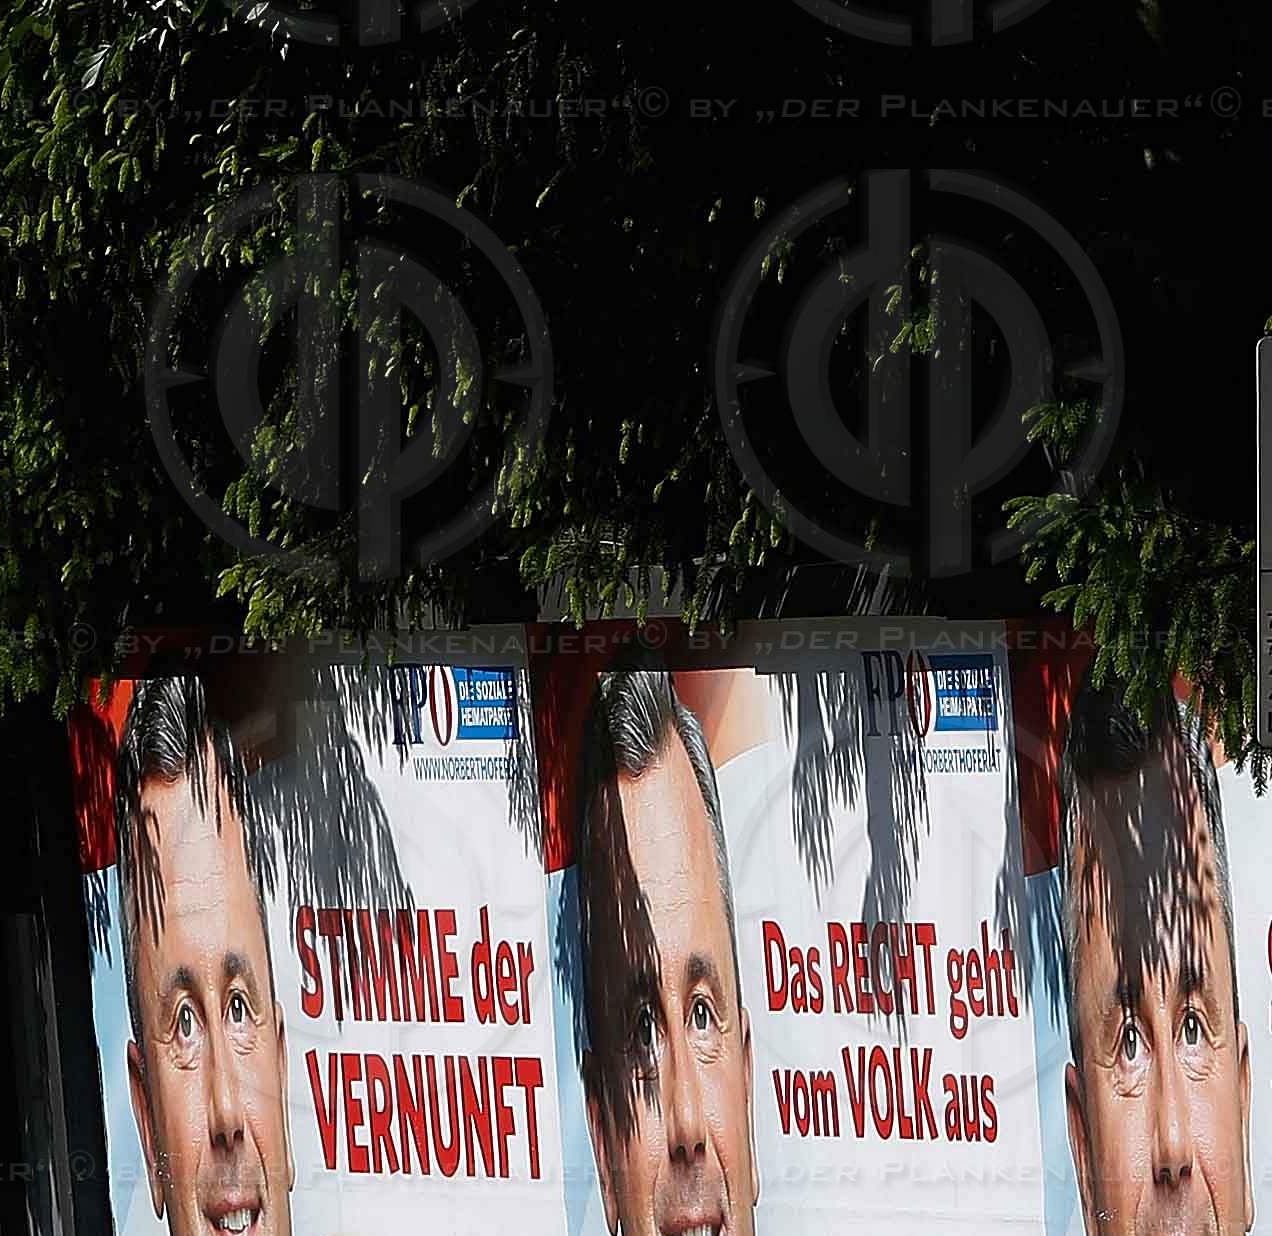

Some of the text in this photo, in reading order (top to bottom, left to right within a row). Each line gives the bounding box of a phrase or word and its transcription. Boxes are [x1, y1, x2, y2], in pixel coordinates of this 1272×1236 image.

[296, 904, 535, 1025] STIMME der
[762, 919, 1020, 1040] Das RECHT geht
[304, 1048, 545, 1180] VERNUNFT
[772, 1045, 999, 1144] vom VOLK aus
